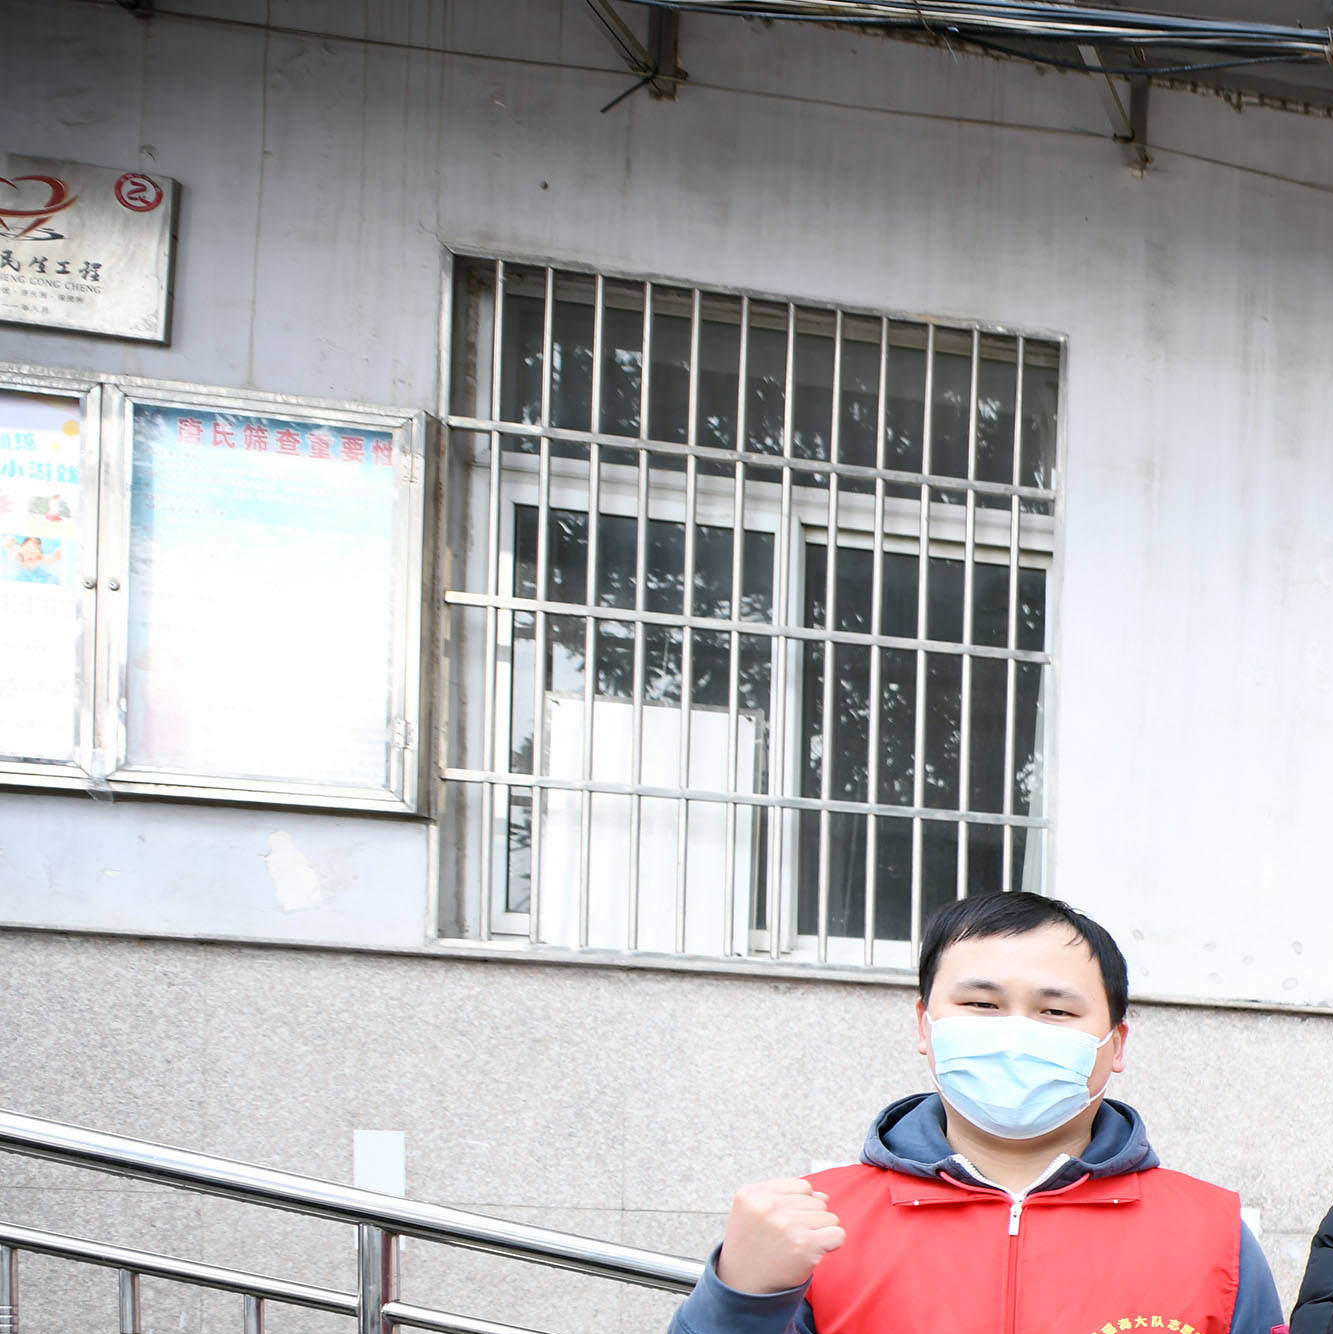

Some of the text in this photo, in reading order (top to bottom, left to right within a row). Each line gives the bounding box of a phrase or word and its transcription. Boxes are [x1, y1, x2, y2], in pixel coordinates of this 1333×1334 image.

[65, 281, 102, 294] CHENG
[177, 417, 393, 466] 唐氏筛查重要性
